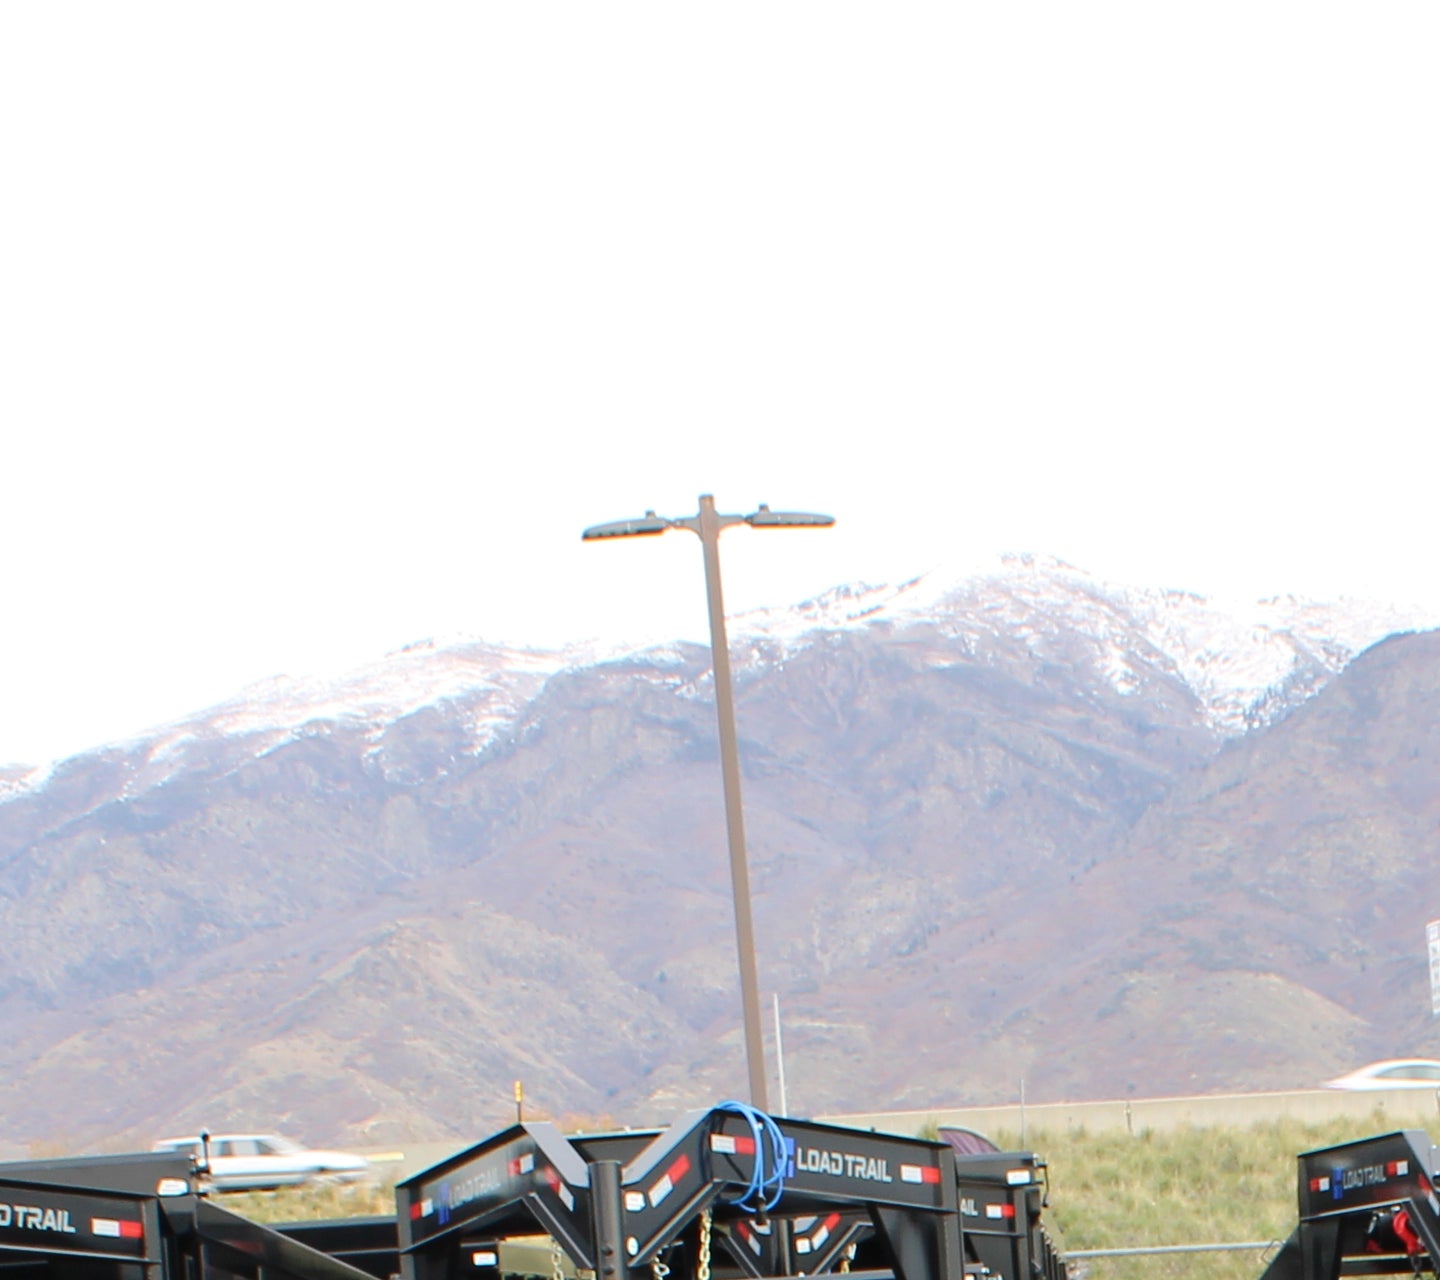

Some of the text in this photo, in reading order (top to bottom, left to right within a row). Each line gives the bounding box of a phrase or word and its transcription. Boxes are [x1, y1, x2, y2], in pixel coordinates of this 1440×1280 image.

[797, 1147, 892, 1183] LOAD TRAIL
[14, 1206, 76, 1233] TRAIL
[960, 1198, 978, 1216] AIL
